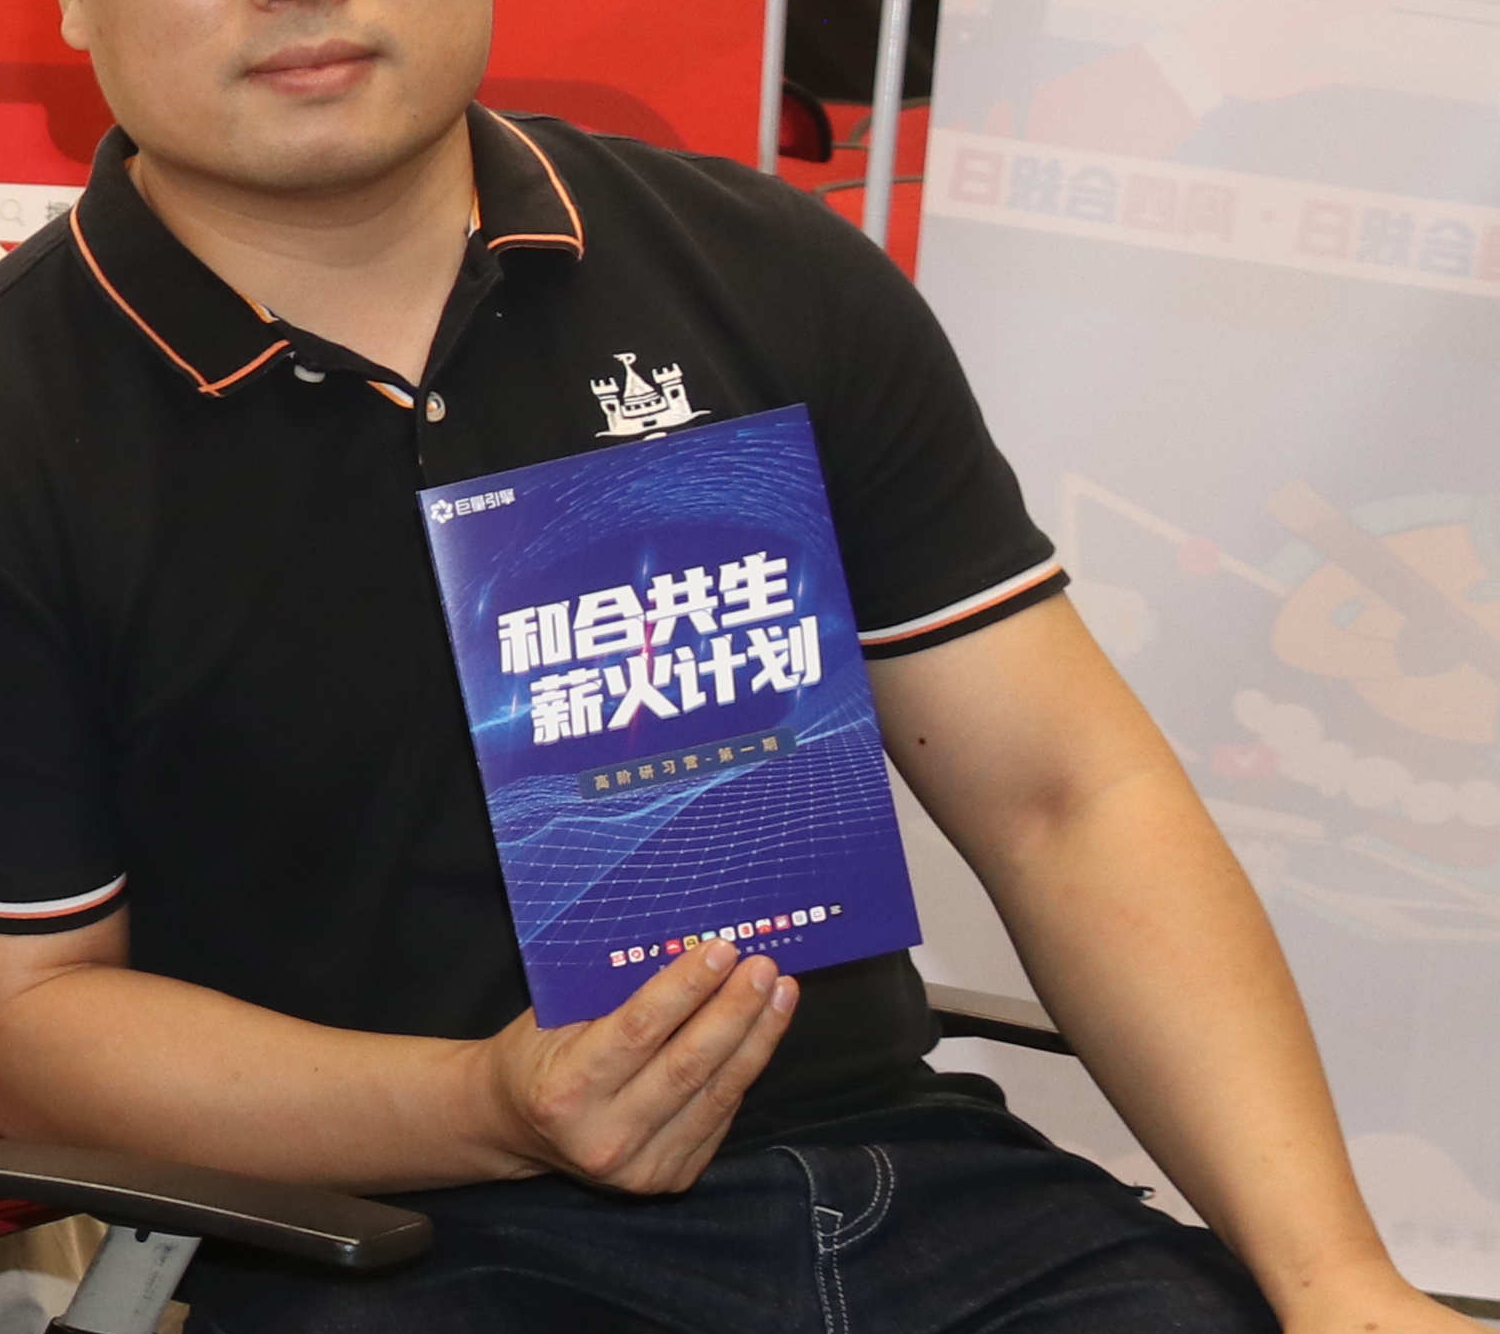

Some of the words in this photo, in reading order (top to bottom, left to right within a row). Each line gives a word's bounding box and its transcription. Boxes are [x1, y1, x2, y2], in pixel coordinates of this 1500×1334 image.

[454, 488, 516, 516] 巨量引擎
[497, 551, 797, 675] 和合共生
[530, 615, 822, 746] 薪火计划
